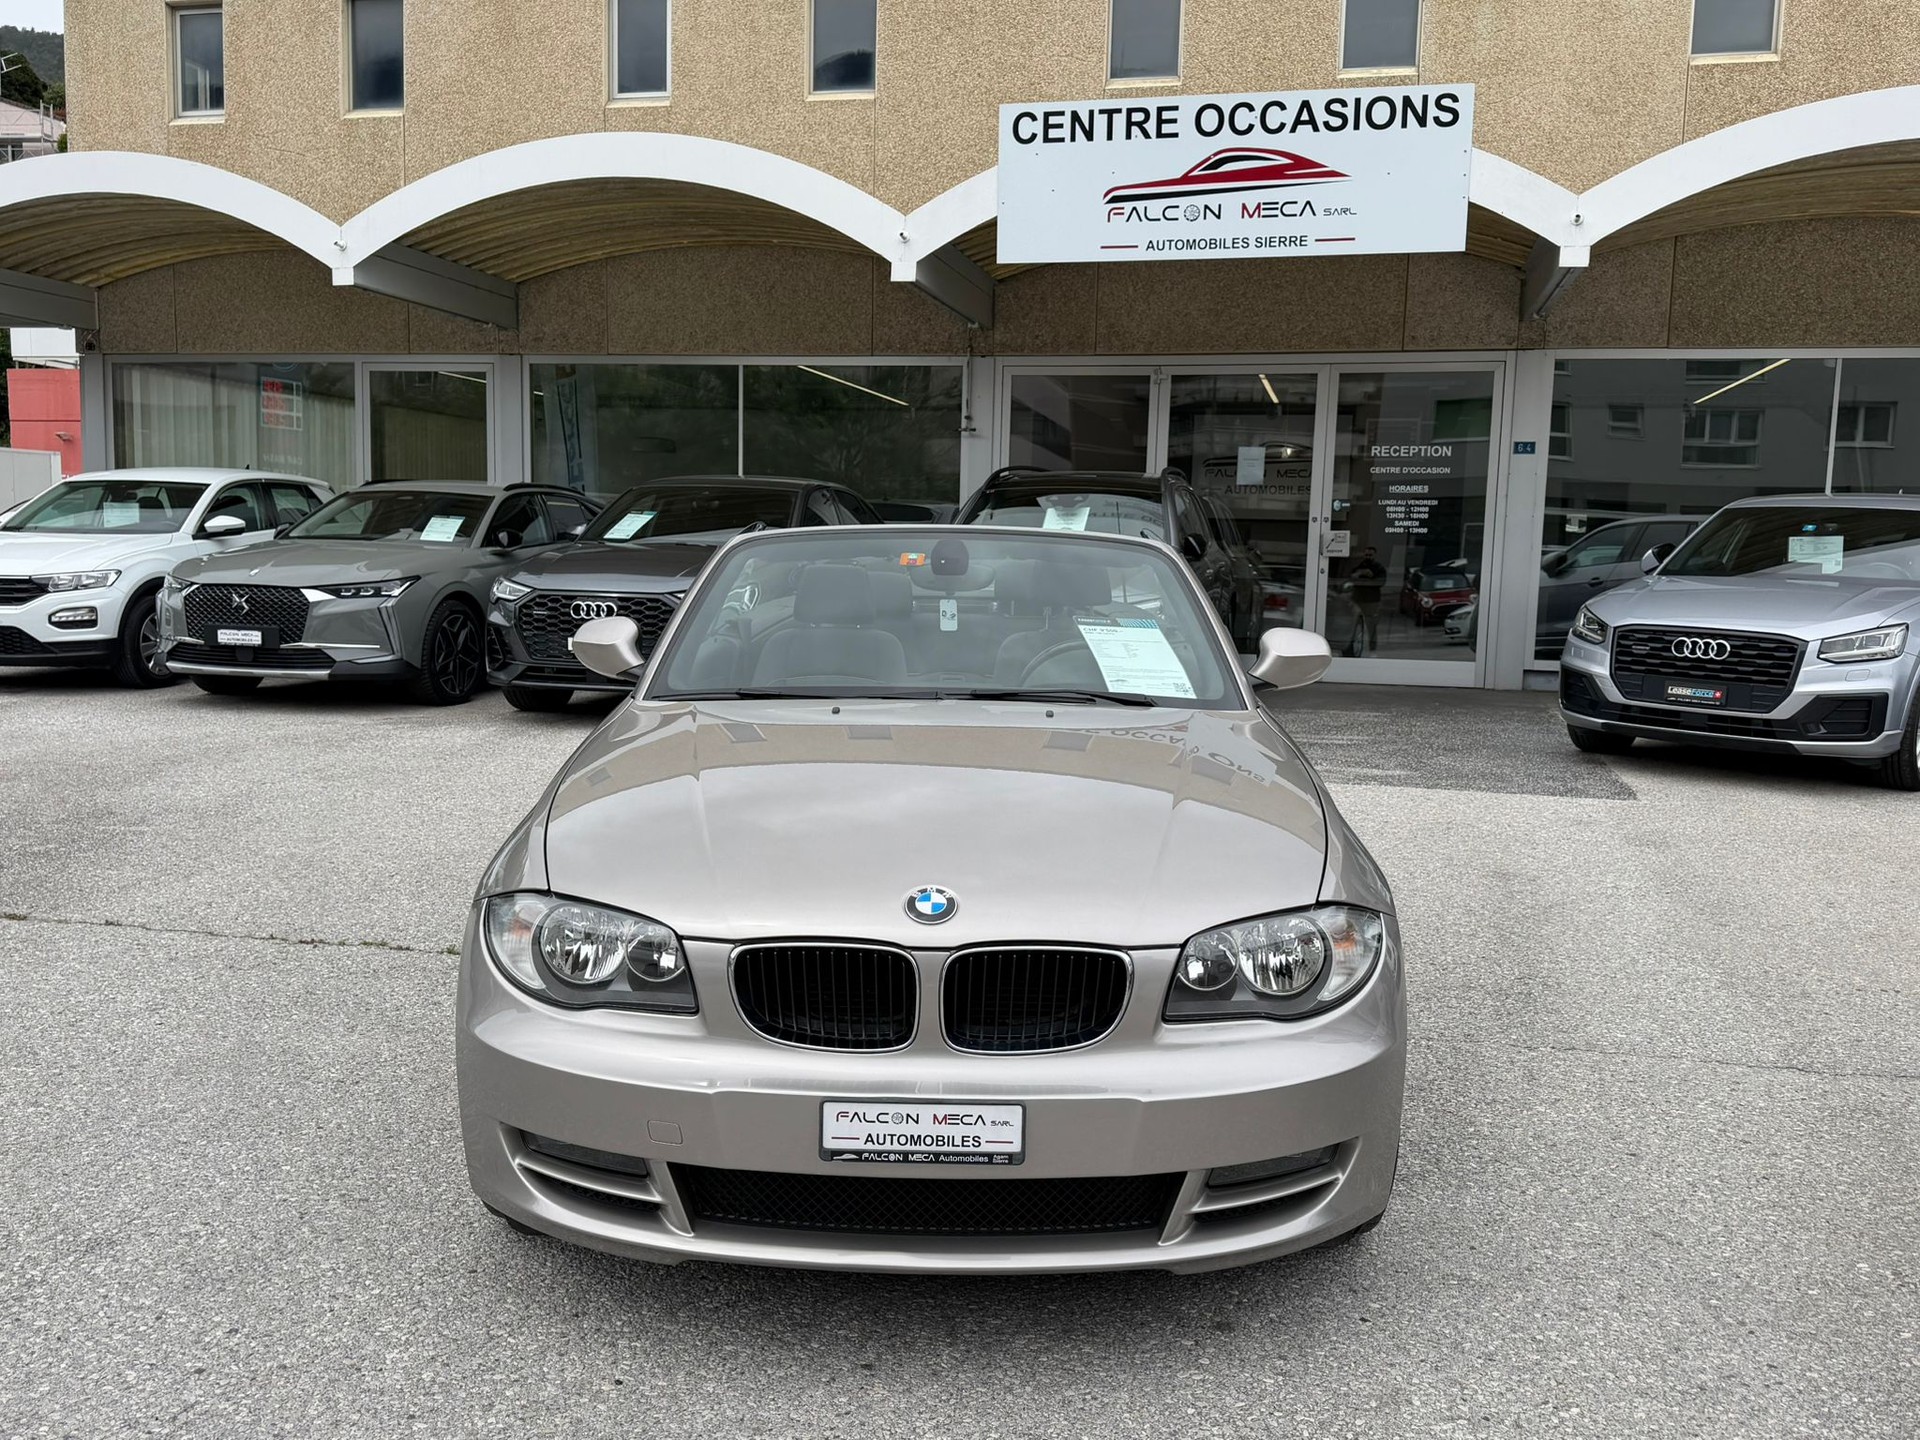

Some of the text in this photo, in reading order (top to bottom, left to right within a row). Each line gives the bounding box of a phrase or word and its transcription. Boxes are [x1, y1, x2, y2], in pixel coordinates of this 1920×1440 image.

[1012, 91, 1461, 145] CENTRE OCCASIONS
[1106, 200, 1358, 223] FALCON MECA SARL
[1145, 234, 1309, 252] AUTOMOBILES SIERRE
[1371, 445, 1452, 457] RECEPTION
[1402, 466, 1451, 474] D'OCCASION
[1389, 485, 1429, 493] HORAIRES
[1667, 686, 1714, 698] LeaseForce
[836, 1111, 919, 1124] FALCON
[933, 1113, 986, 1126] MECA
[864, 1133, 982, 1147] AUTOMOBILES
[861, 1152, 903, 1162] FALCON
[908, 1153, 935, 1162] MECA
[938, 1154, 989, 1163] Automobiles
